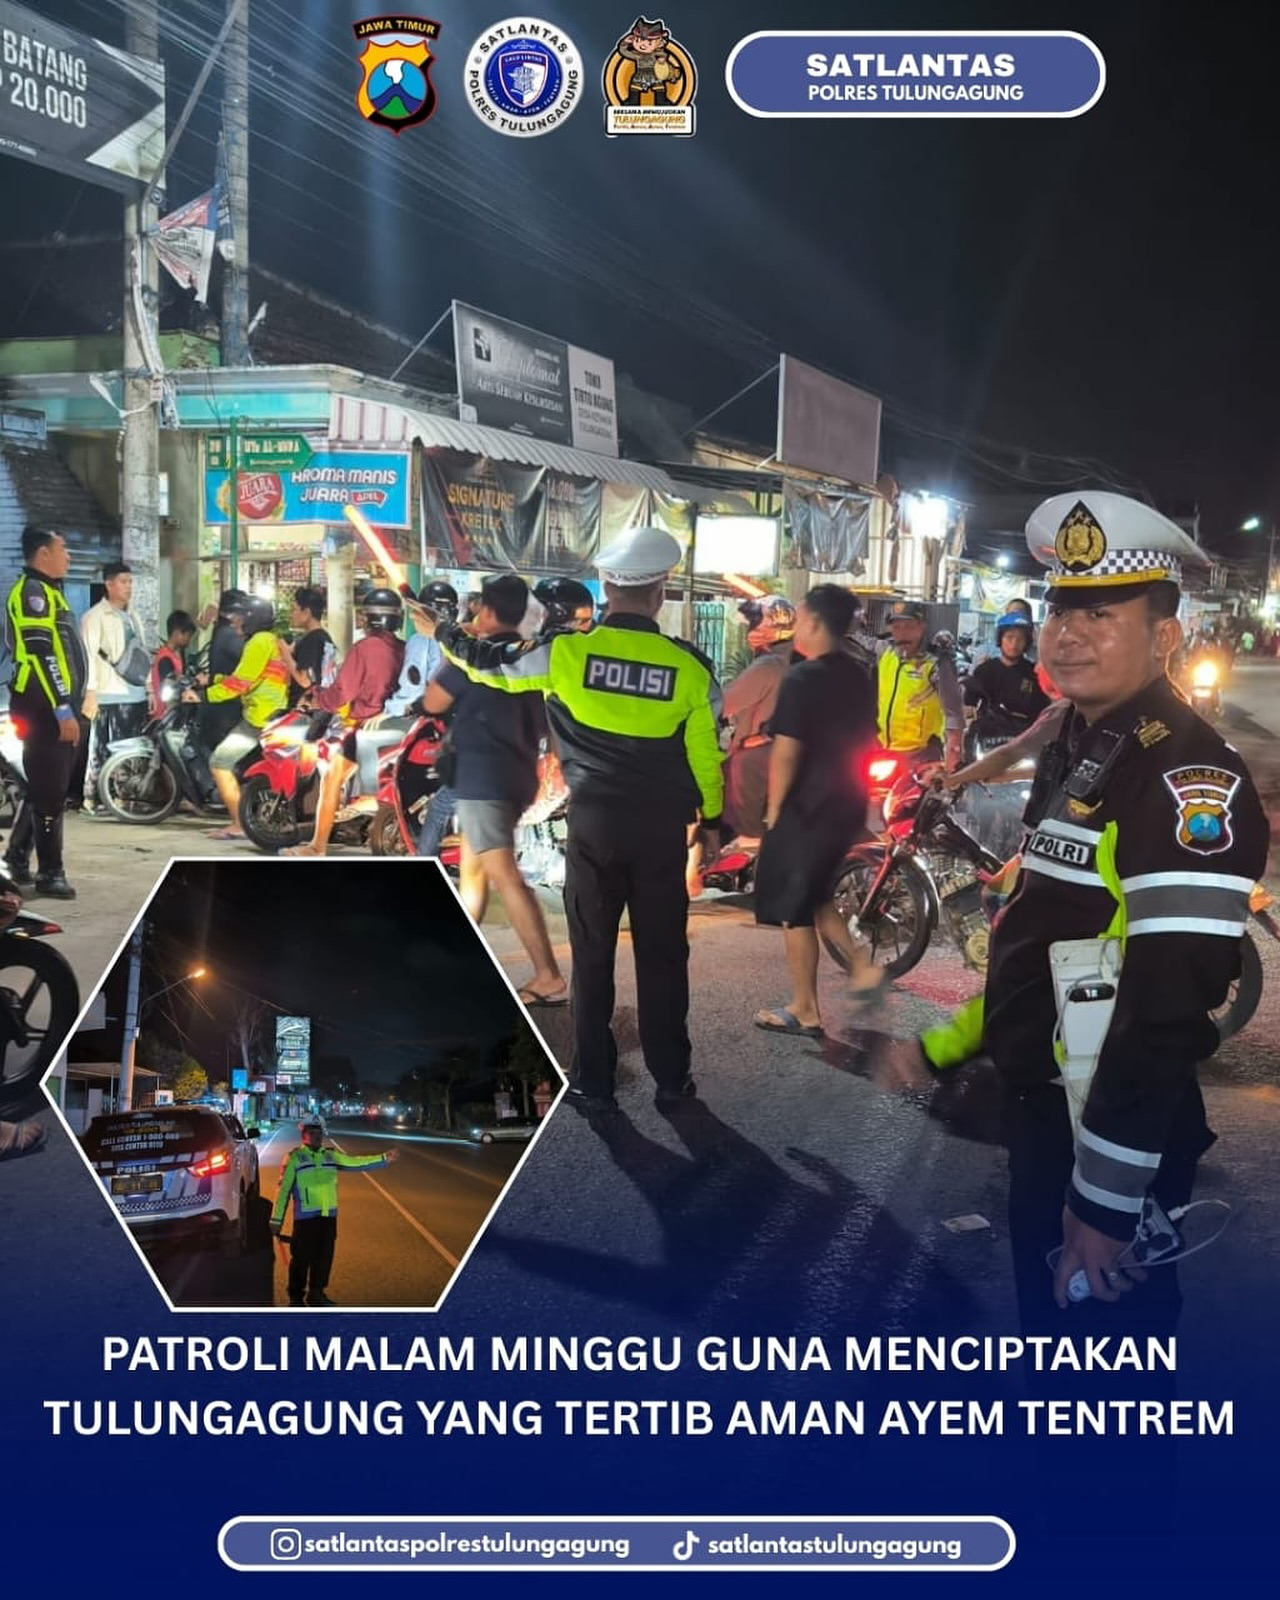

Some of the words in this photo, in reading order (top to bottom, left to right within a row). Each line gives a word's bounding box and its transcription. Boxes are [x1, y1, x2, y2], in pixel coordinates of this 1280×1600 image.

[3, 29, 88, 91] BATANG
[10, 71, 87, 129] 20.000
[240, 477, 276, 500] JUARA
[291, 468, 347, 484] AROMA
[348, 469, 398, 484] MANIS
[301, 487, 349, 503] JUARA
[448, 483, 515, 513] SIGNATURE
[588, 660, 671, 696] POLISI
[1034, 836, 1084, 862] POLRI
